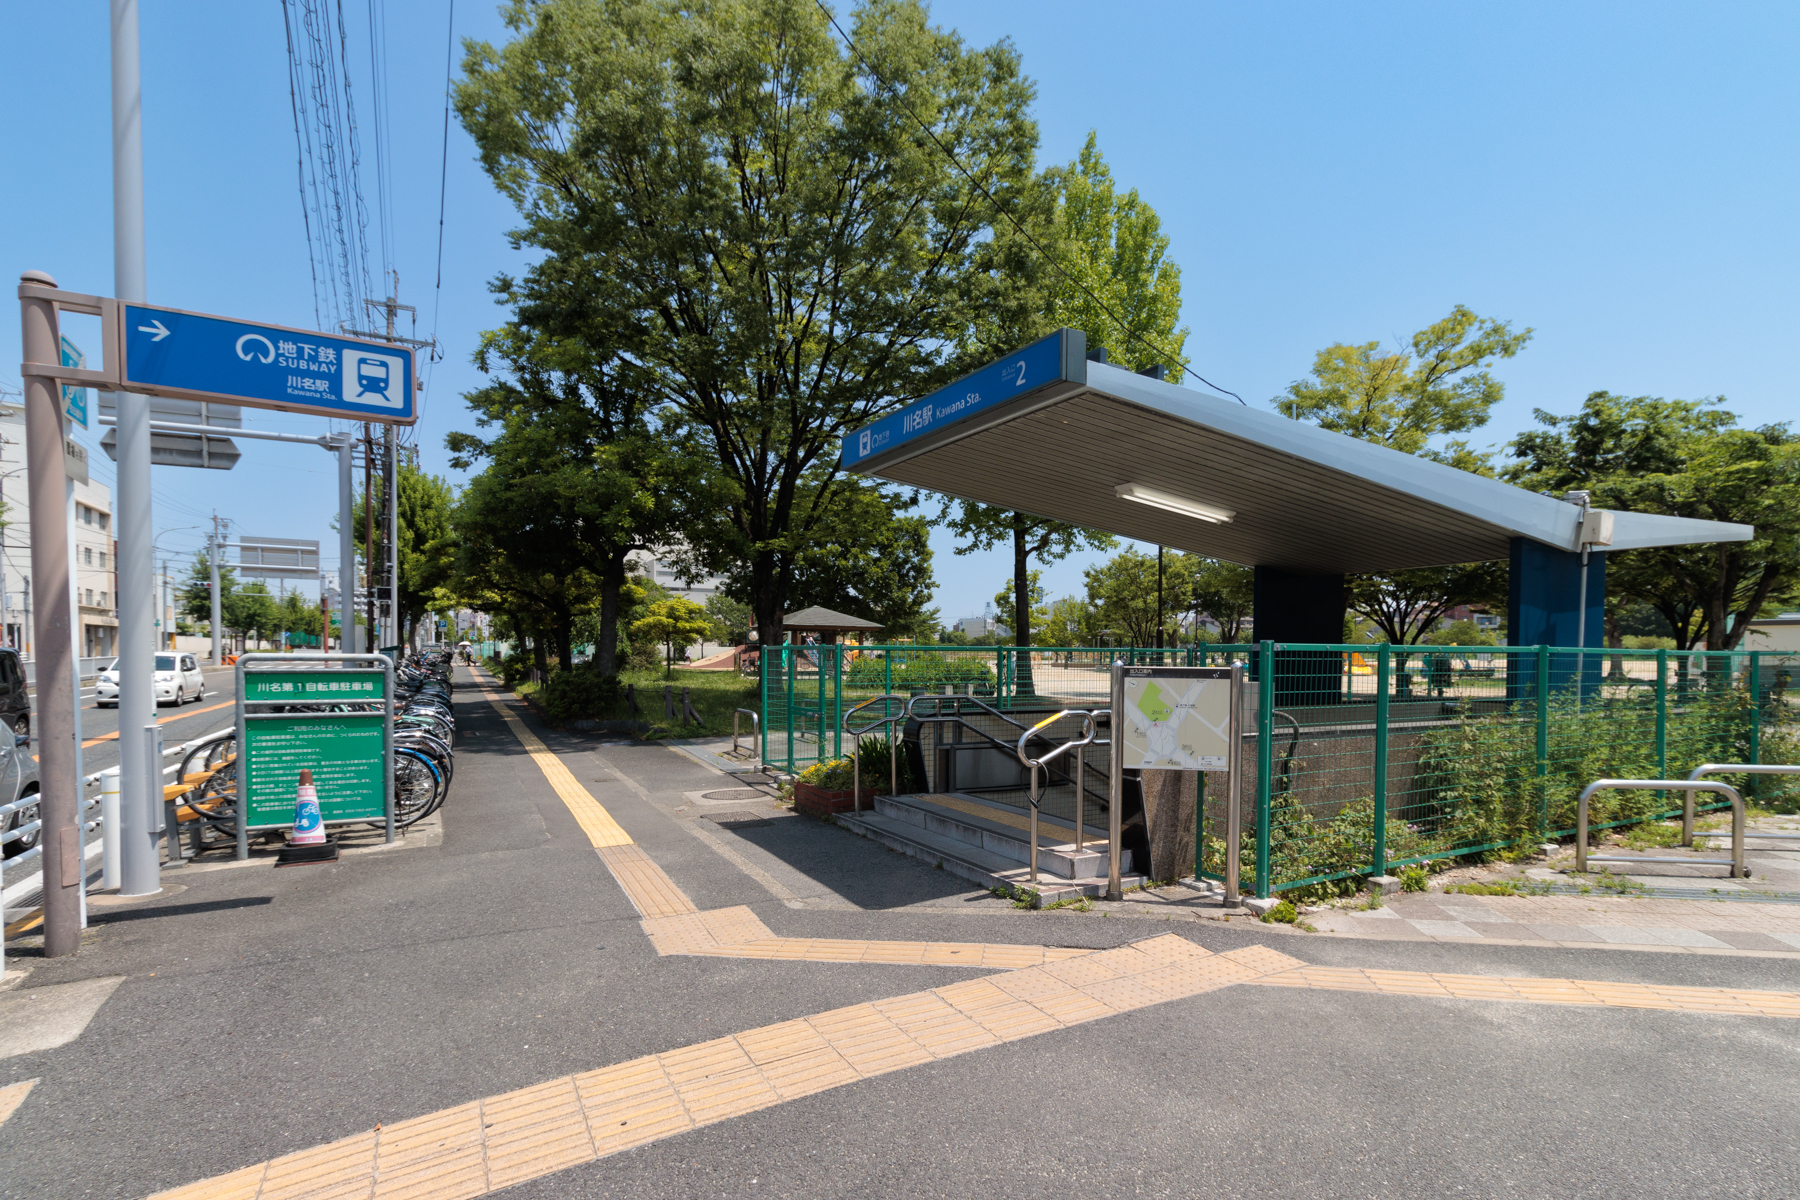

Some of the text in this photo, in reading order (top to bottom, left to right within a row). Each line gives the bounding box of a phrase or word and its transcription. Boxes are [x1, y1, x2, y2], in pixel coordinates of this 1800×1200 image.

[277, 340, 337, 364] 地下鉄
[278, 356, 337, 374] SUBWAY
[1015, 360, 1026, 386] 2
[286, 375, 330, 392] 川名駅
[287, 387, 338, 401] Kawana Sta.
[903, 393, 982, 435] 川名駅 Kawana Sta.
[257, 681, 374, 693] 川名第1自転車駐車場
[287, 724, 347, 732] ご利用のみなさんへ
